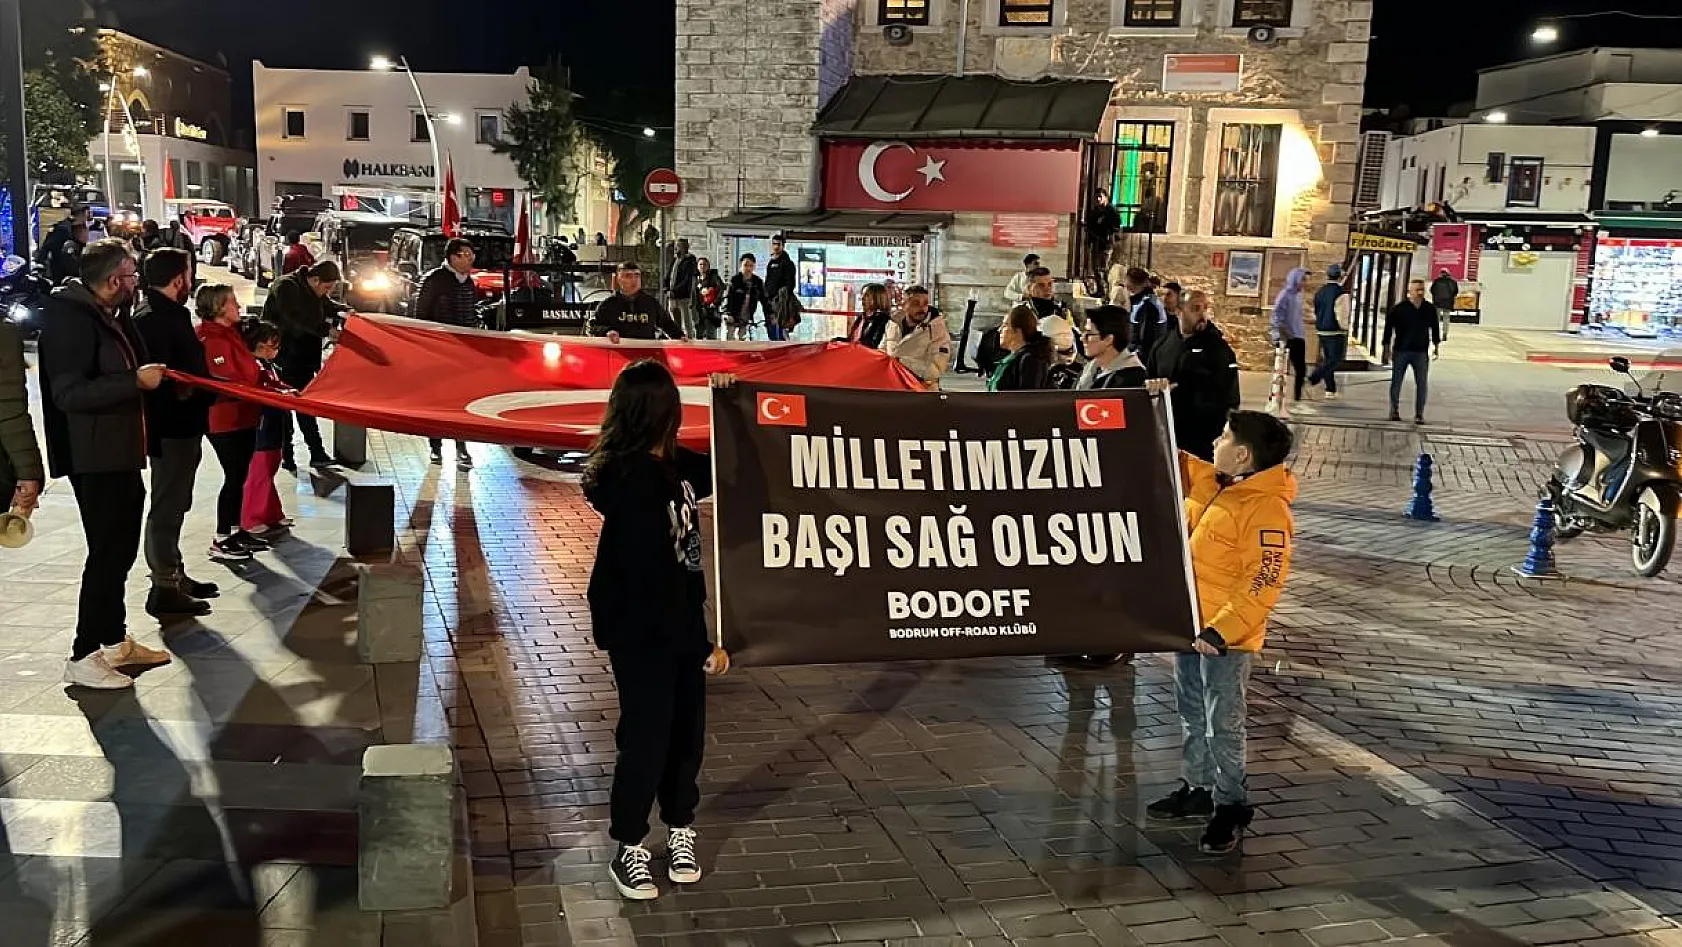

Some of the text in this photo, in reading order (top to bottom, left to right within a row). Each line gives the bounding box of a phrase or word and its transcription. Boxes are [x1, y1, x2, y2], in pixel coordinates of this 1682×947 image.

[790, 425, 1103, 491] MİLLETİMİZİN
[762, 512, 871, 576] BAŞI
[885, 504, 978, 568] SAĞ
[992, 511, 1143, 566] OLSUN
[888, 589, 1031, 619] BODOFF
[940, 626, 998, 637] OFF-ROAD
[999, 622, 1037, 635] KLÜBÜ
